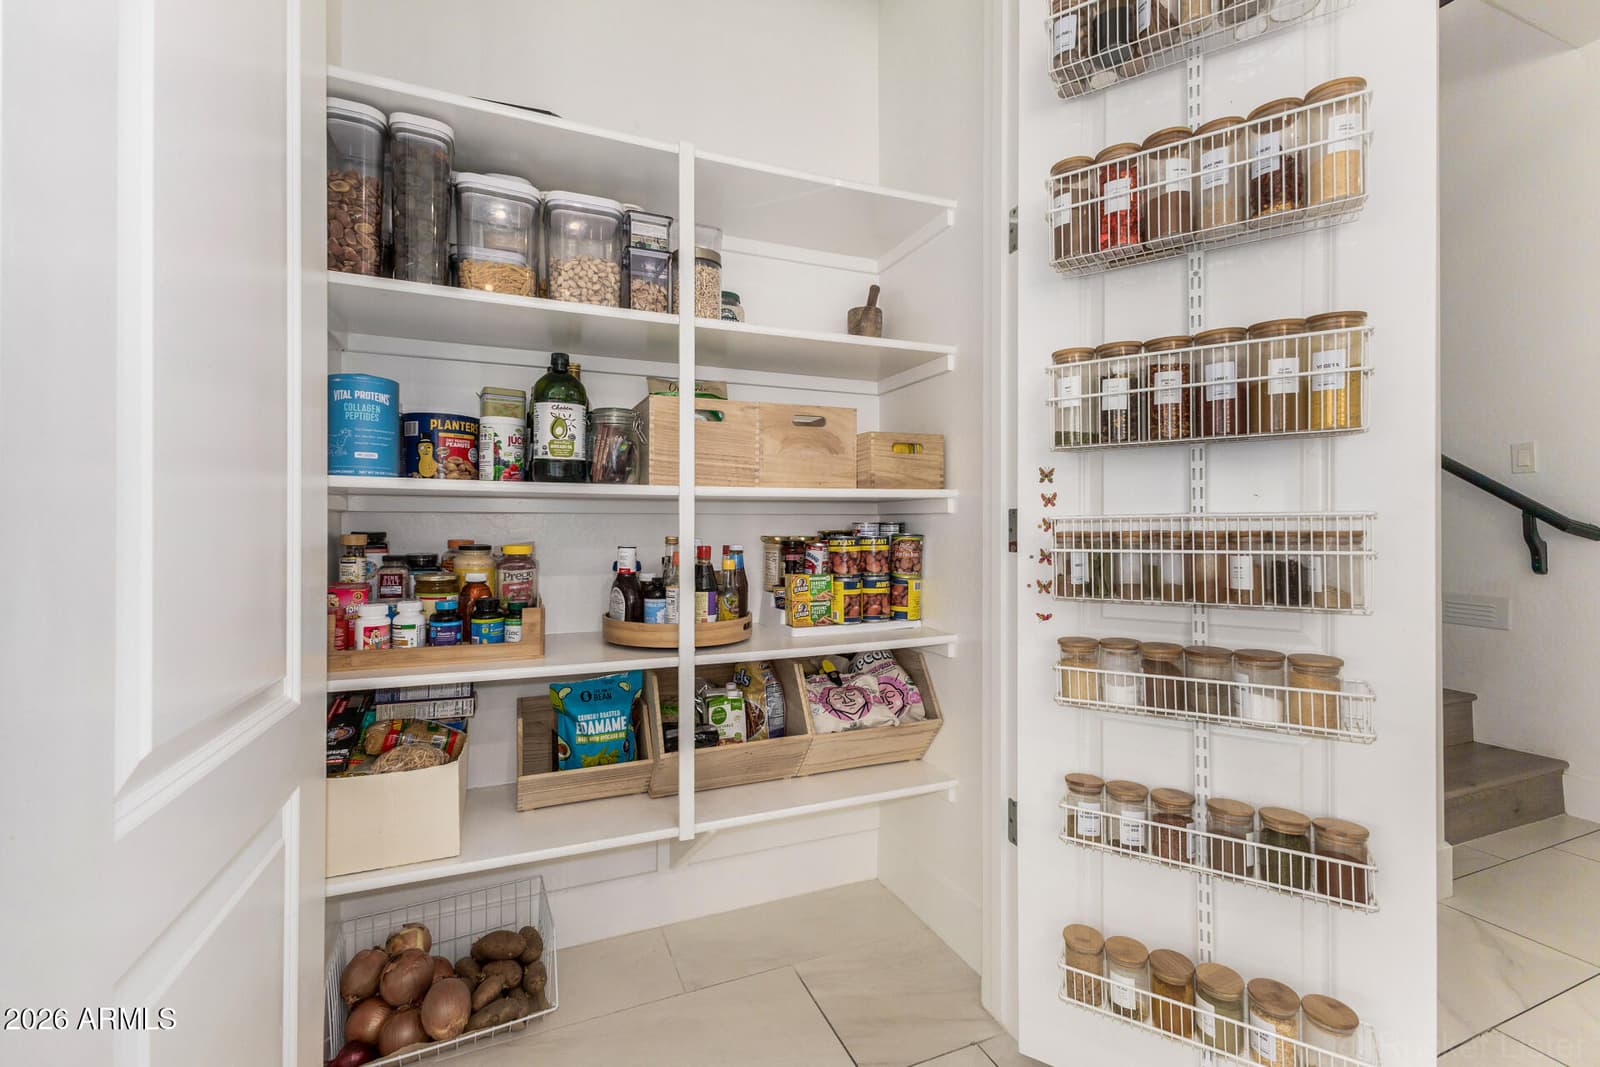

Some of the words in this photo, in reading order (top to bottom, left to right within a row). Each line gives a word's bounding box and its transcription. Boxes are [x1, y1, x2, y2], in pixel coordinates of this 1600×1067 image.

[333, 389, 352, 401] VITAL
[354, 390, 391, 406] PROTEINS
[343, 402, 381, 413] COLLAGEN
[344, 411, 380, 422] PEPTIDES
[430, 418, 479, 434] PLANTERS
[446, 441, 471, 449] PEANUTS
[503, 571, 534, 583] Prego
[577, 713, 599, 722] CRUNCHY
[600, 709, 621, 719] ROASTED
[575, 715, 627, 735] EDAMAME
